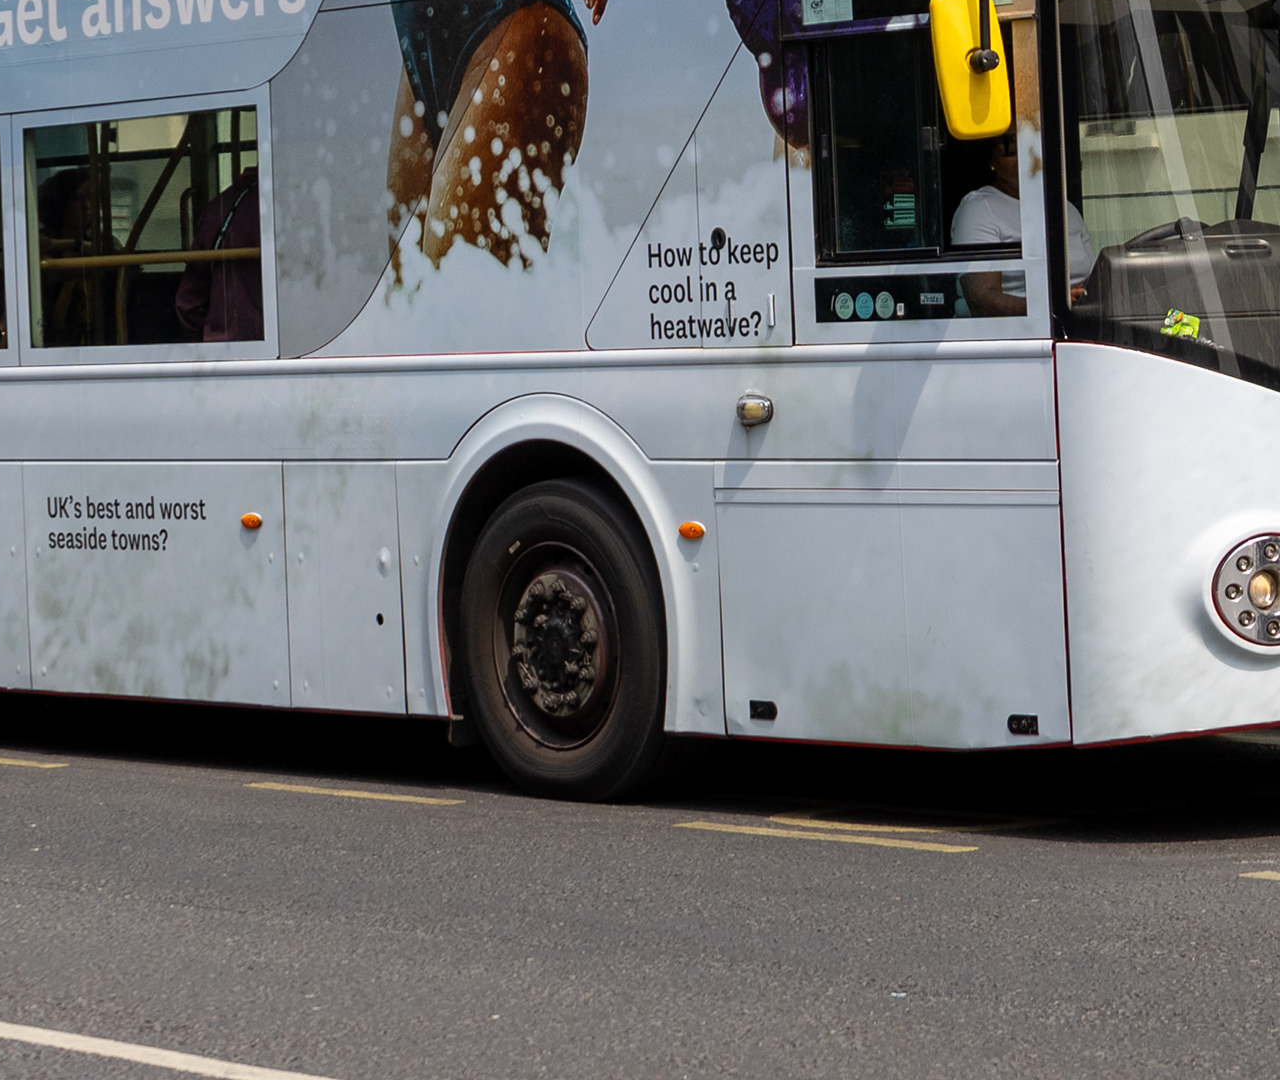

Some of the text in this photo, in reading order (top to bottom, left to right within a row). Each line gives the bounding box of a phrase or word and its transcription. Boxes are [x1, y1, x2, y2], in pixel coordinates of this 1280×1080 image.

[647, 236, 779, 270] How to keep
[648, 275, 737, 305] cool in a
[650, 310, 762, 340] heatwave?
[46, 494, 207, 521] UK’s best and worst
[48, 526, 169, 552] seaside towns?
